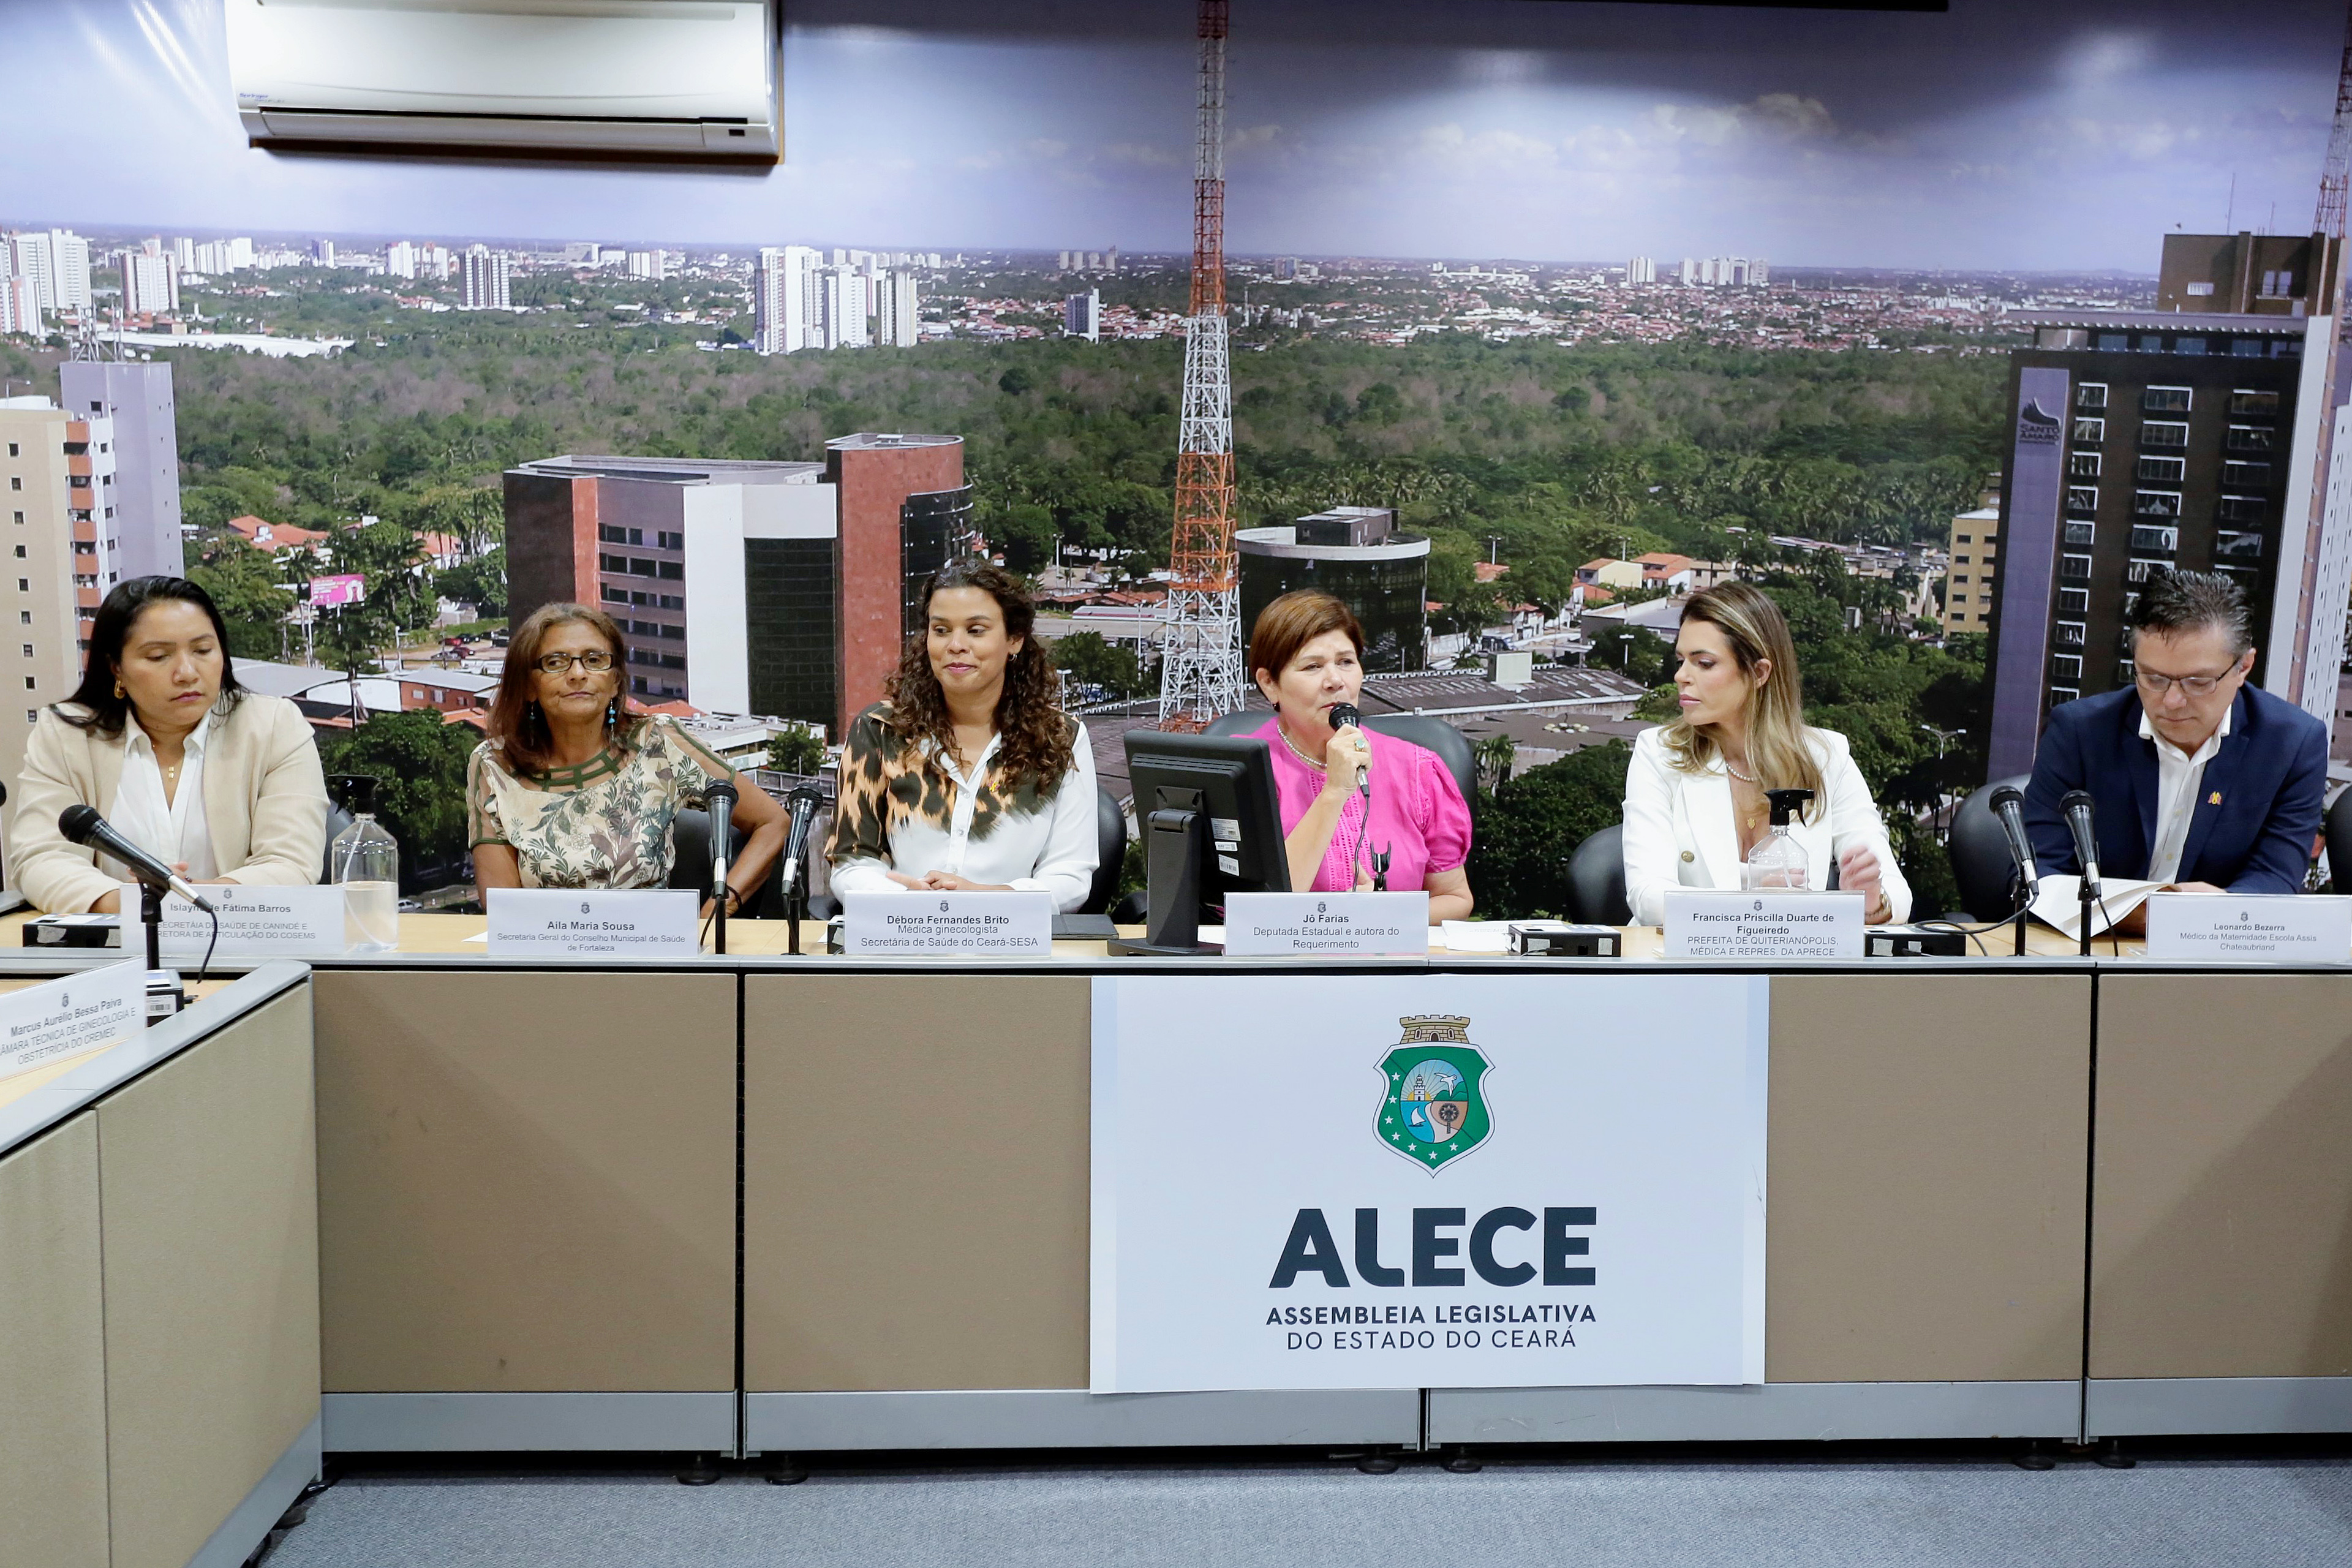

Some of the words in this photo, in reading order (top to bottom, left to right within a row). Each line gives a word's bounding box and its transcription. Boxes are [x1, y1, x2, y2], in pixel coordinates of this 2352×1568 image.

[170, 903, 205, 913] Islayn
[887, 915, 924, 924] Débora
[927, 916, 981, 924] Fernandes
[984, 916, 1009, 924] Brito
[1303, 914, 1314, 923] Jô
[1319, 914, 1349, 923] Farias
[1693, 913, 1741, 922] Francisca
[1744, 913, 1783, 922] Priscilla
[1822, 914, 1834, 922] de
[548, 921, 567, 930] Aila
[898, 925, 932, 933] Médica
[935, 925, 998, 936] ginecologista
[206, 930, 263, 939] ATICULAÇÃO
[1254, 927, 1298, 937] Deputada
[1302, 927, 1343, 936] Estadual
[1387, 927, 1400, 936] do
[1737, 926, 1789, 937] Figueiredo
[611, 935, 646, 943] Municipal
[861, 938, 910, 946] Secretária
[913, 938, 924, 946] de
[928, 938, 959, 946] Saúde
[962, 938, 974, 946] do
[977, 938, 1038, 946] Ceará-SESA
[1751, 935, 1838, 946] QUITERIANÓPOLIS,
[1293, 940, 1359, 950] Requerimento
[1691, 946, 1727, 956] MÉDICA
[10, 1022, 41, 1037] Marcus
[44, 1012, 72, 1028] Aurélio
[75, 1005, 99, 1019] Bessa
[101, 998, 122, 1011] Paiva
[0, 1039, 29, 1057] ÂMARA
[32, 1029, 64, 1046] TÉCNICA
[67, 1025, 77, 1036] DE
[79, 1009, 130, 1032] GINECOLOGIA
[131, 1007, 136, 1017] E
[18, 1041, 70, 1065] OBSTETRÍCIA
[72, 1038, 82, 1049] DO
[84, 1027, 116, 1044] CREMEC
[1268, 1207, 1597, 1288] ALECE
[1265, 1306, 1426, 1325] ASSEMBLEIA
[1435, 1305, 1596, 1324] LEGISLATIVA
[1288, 1331, 1322, 1350] DO
[1335, 1330, 1434, 1349] ESTADO
[1446, 1330, 1481, 1349] DO
[1491, 1325, 1576, 1348] CEARÁ
